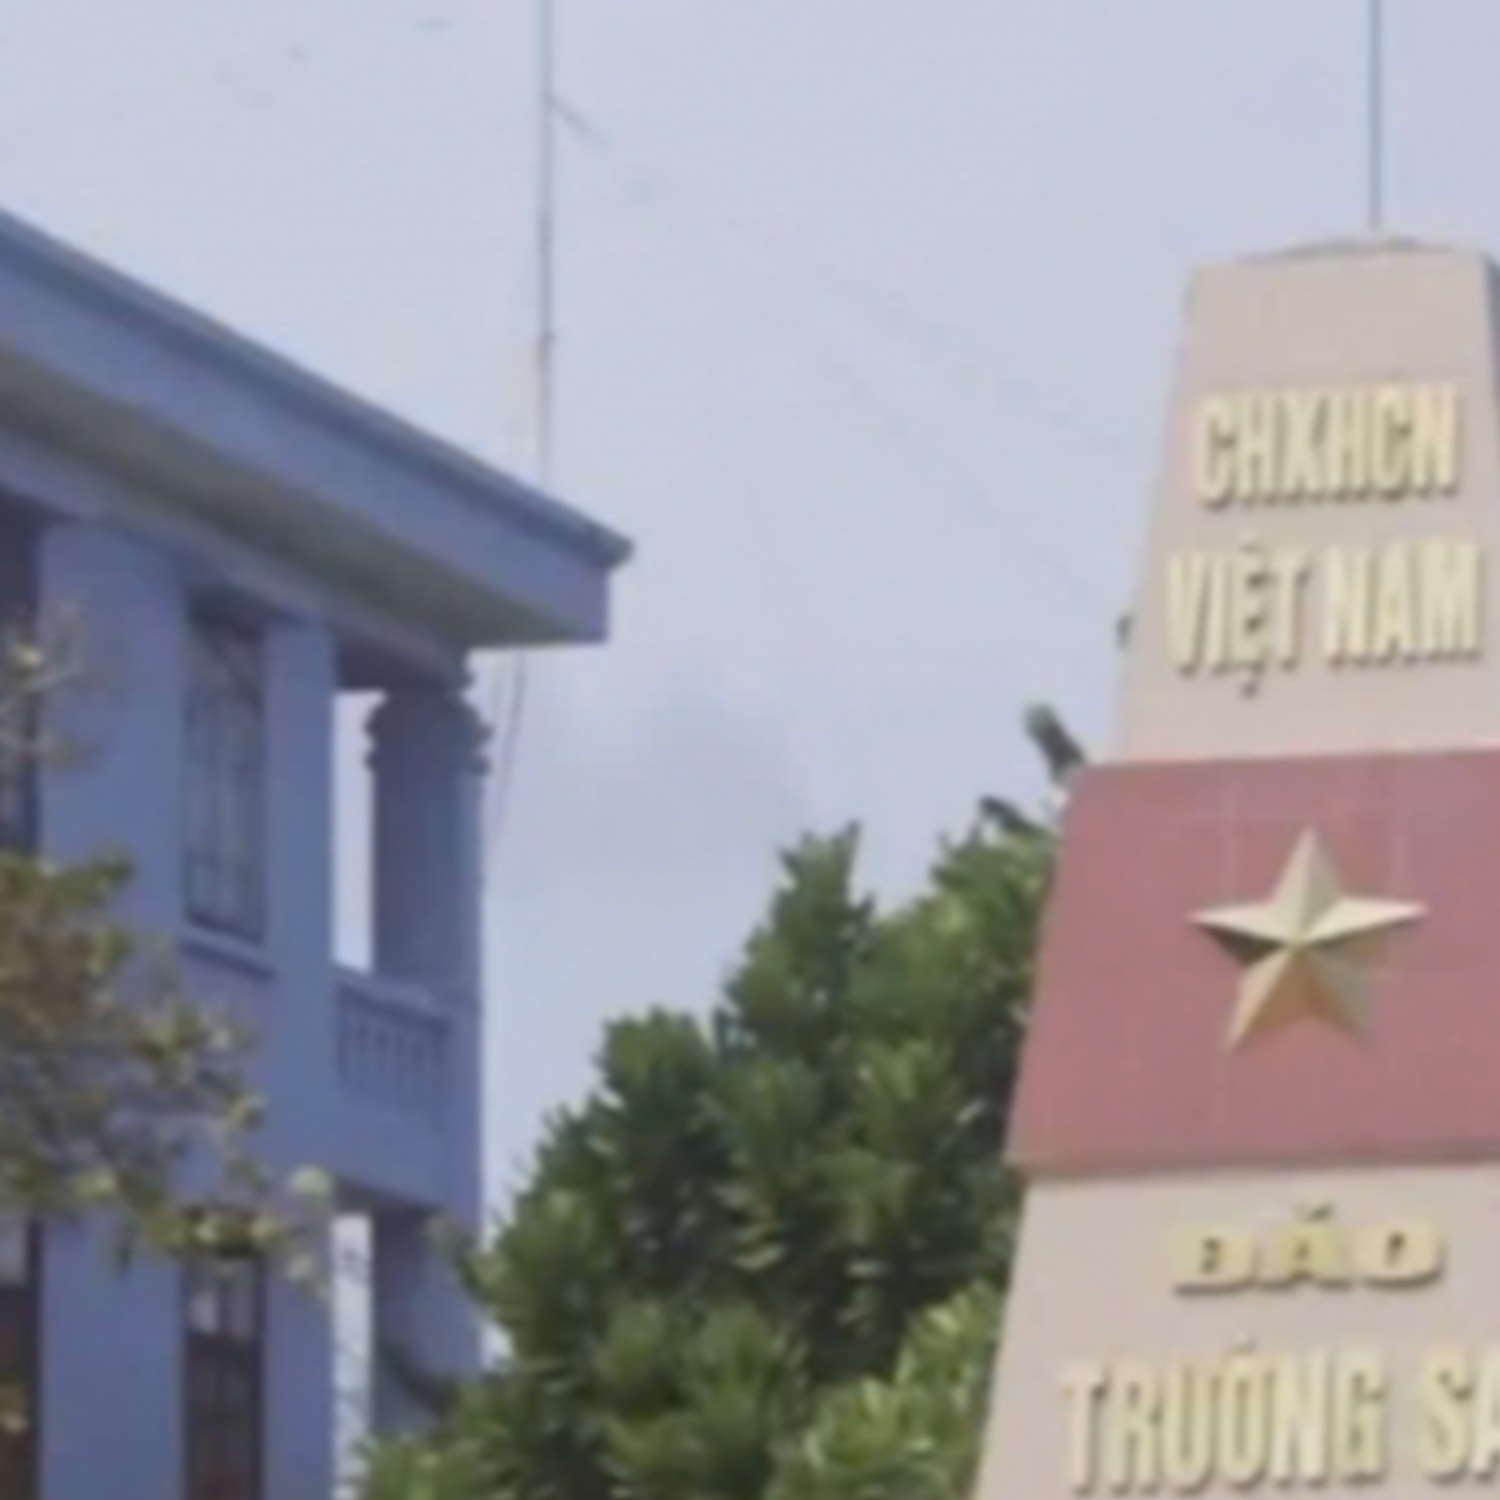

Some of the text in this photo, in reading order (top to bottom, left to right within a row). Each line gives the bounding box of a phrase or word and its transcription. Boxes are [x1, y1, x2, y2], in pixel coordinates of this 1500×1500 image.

[1196, 382, 1460, 504] CHXHCN
[1166, 532, 1308, 698] VIỆT
[1322, 538, 1482, 662] NAM
